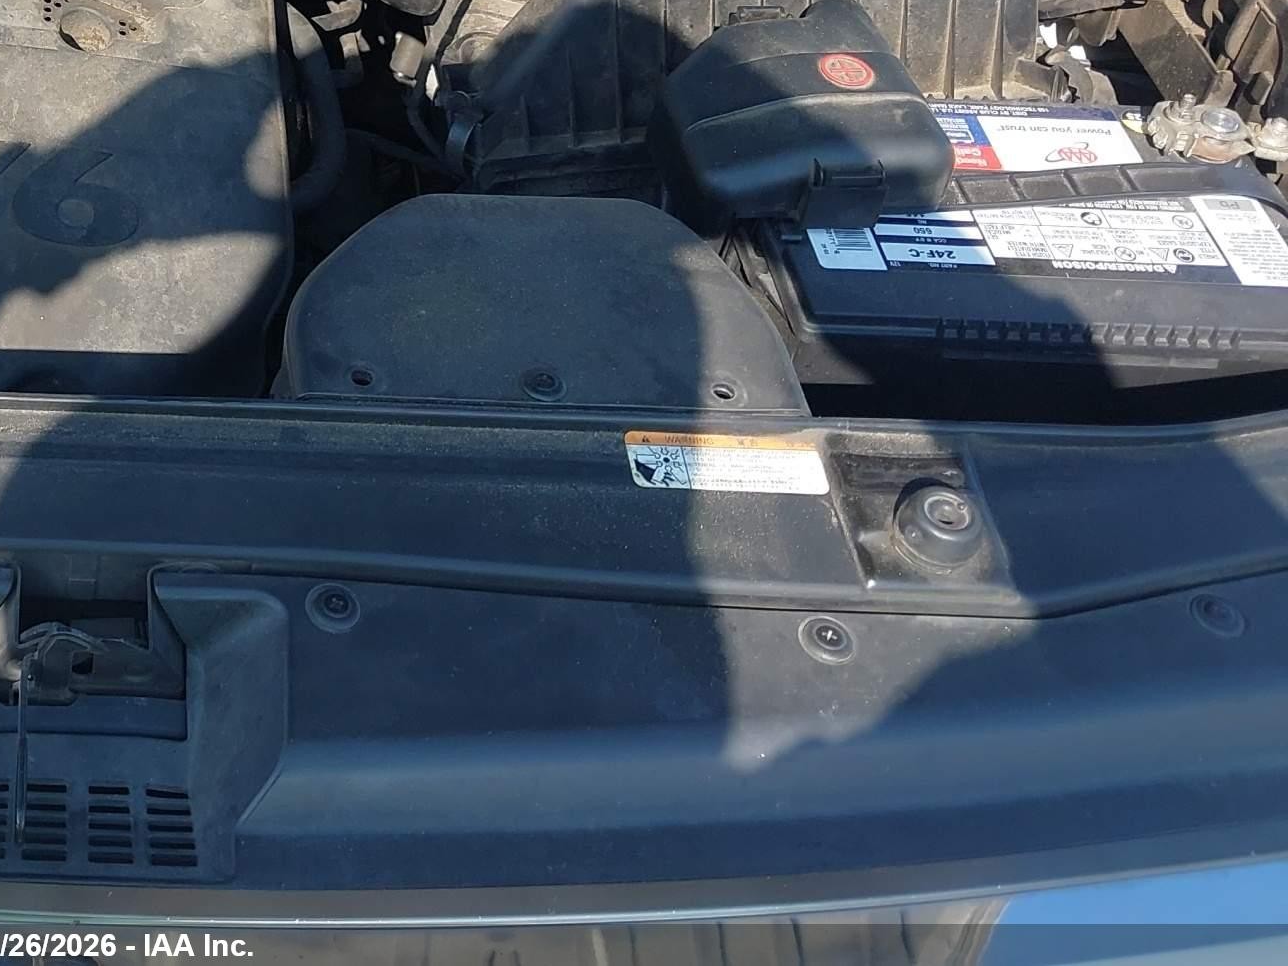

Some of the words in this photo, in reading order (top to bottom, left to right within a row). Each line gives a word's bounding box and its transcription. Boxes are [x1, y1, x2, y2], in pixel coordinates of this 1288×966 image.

[999, 124, 1026, 132] trust
[1051, 126, 1072, 134] you
[1075, 127, 1112, 136] Power
[1059, 148, 1097, 163] AAA
[1220, 201, 1240, 210] Pb
[913, 226, 932, 235] 650
[908, 248, 957, 259] 24F-C
[1052, 261, 1165, 273] DANGER/POISON
[664, 436, 714, 444] WARNING
